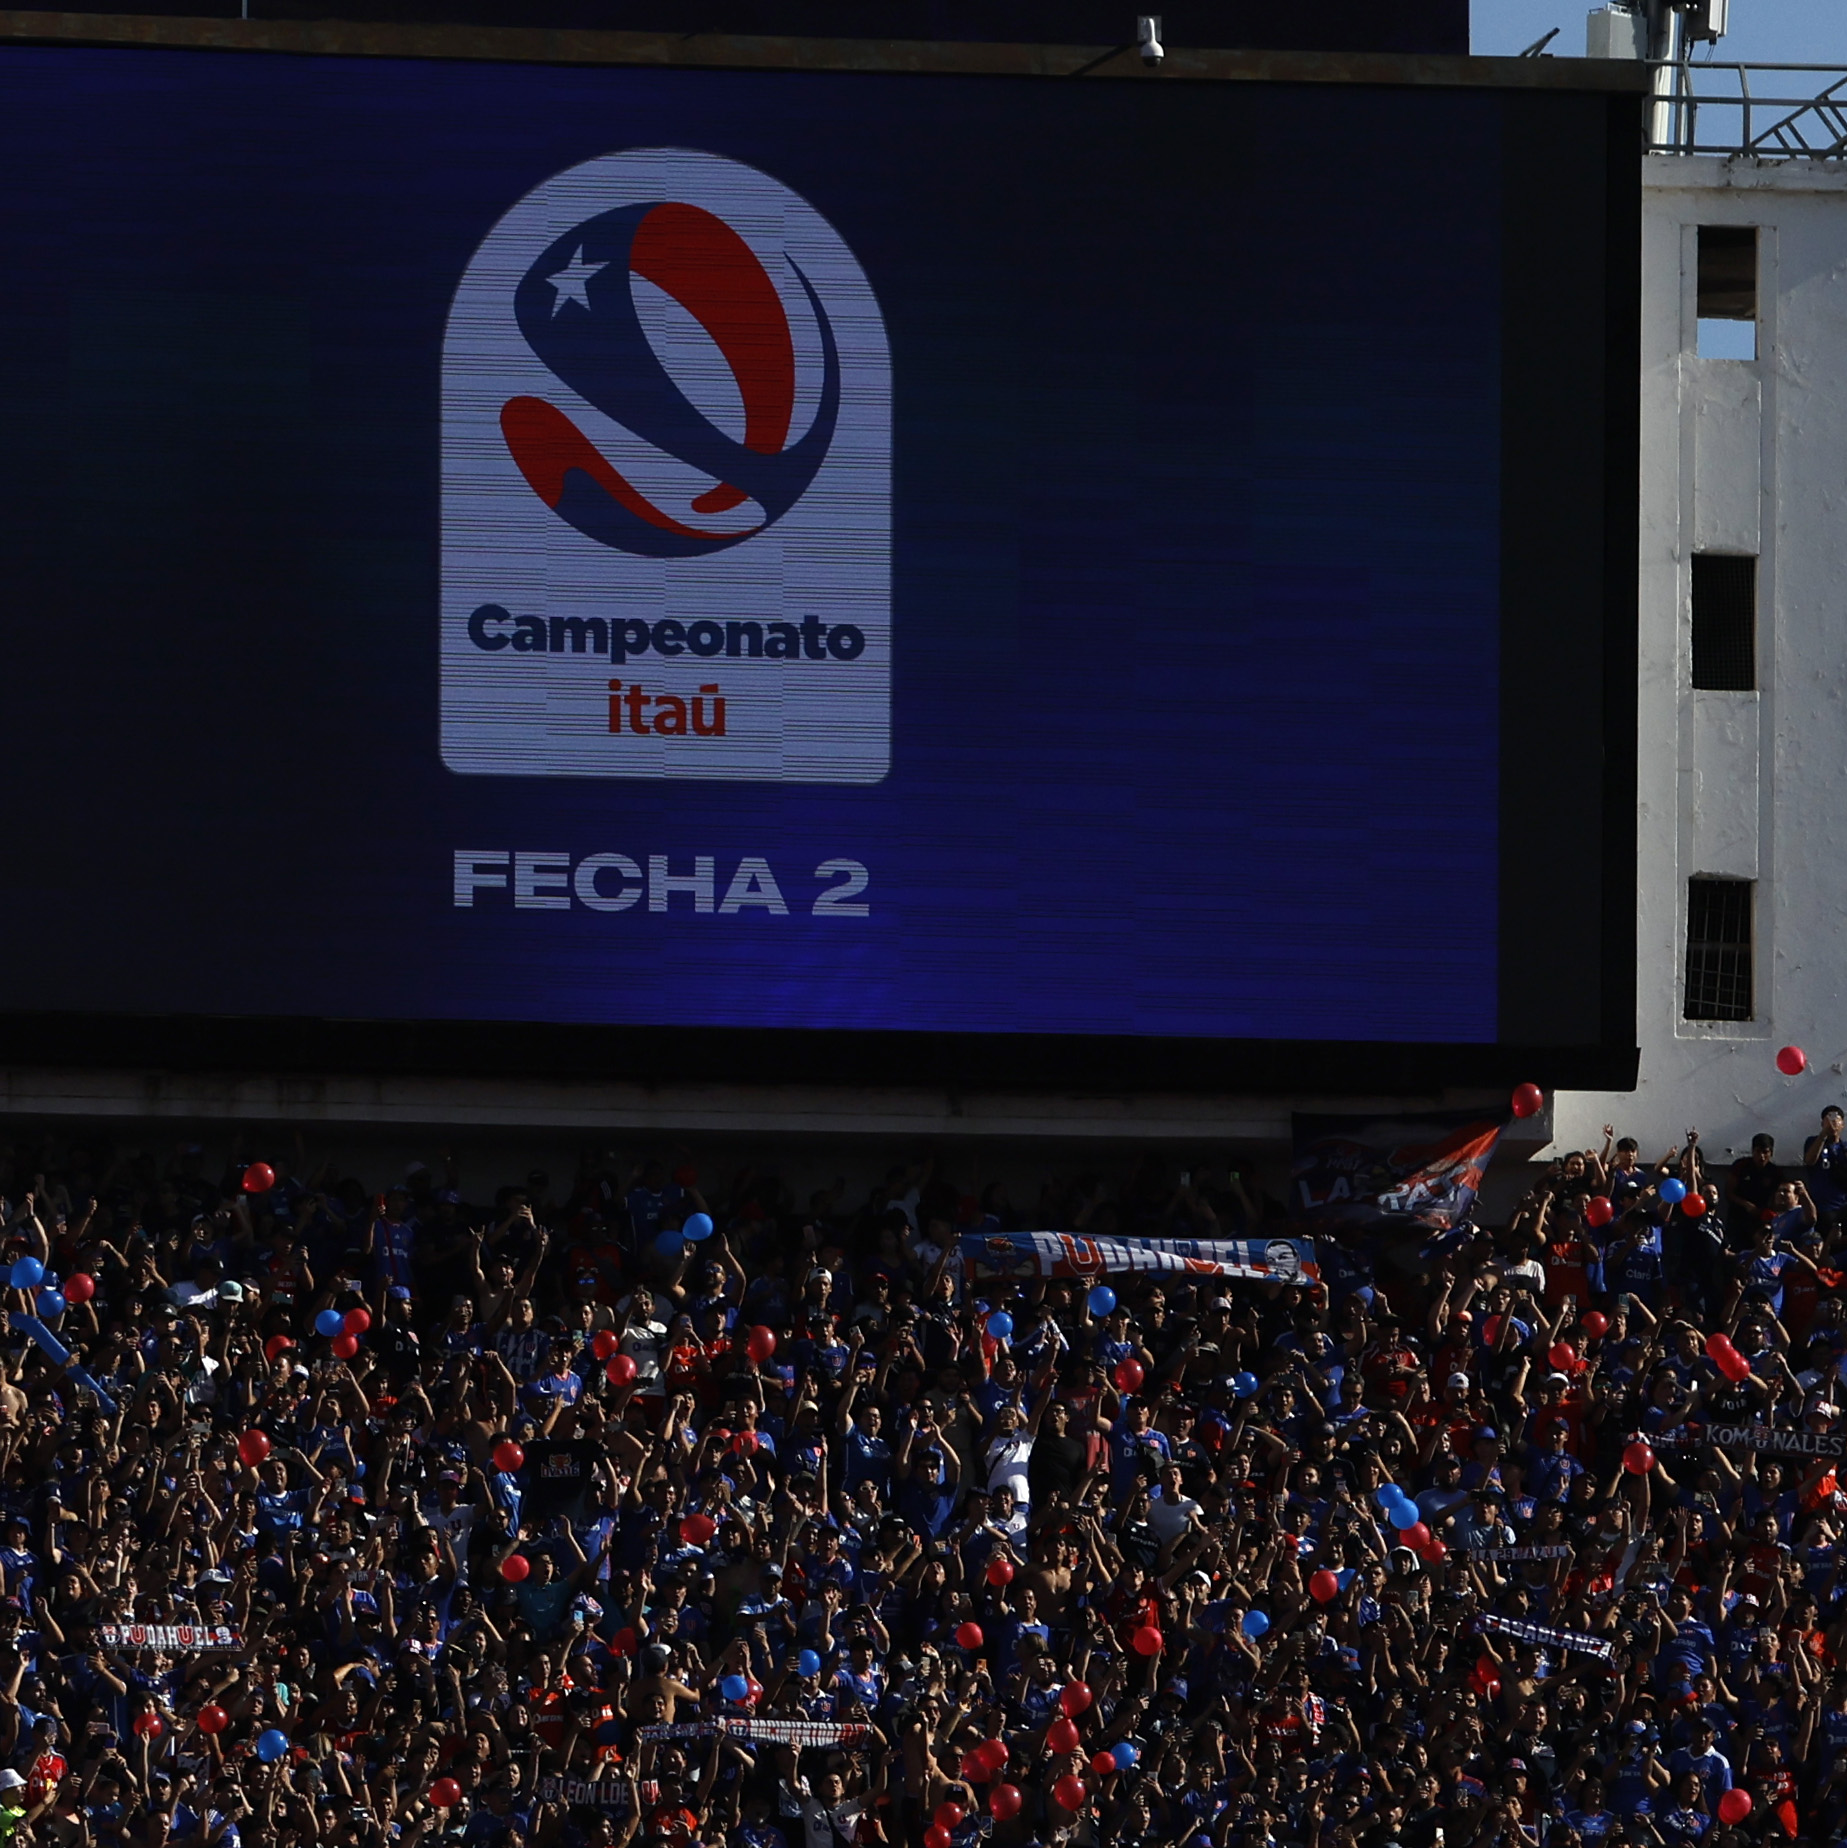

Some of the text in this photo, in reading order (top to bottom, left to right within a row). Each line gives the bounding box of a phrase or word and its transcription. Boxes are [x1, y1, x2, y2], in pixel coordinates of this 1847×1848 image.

[467, 604, 866, 664] Campeonato
[607, 681, 725, 737] itaú
[453, 850, 870, 917] FECHA 2
[1031, 1230, 1265, 1277] PUDAHUEL
[119, 1625, 214, 1646] PUDAHUEL
[1485, 1613, 1613, 1658] CASABLANCA
